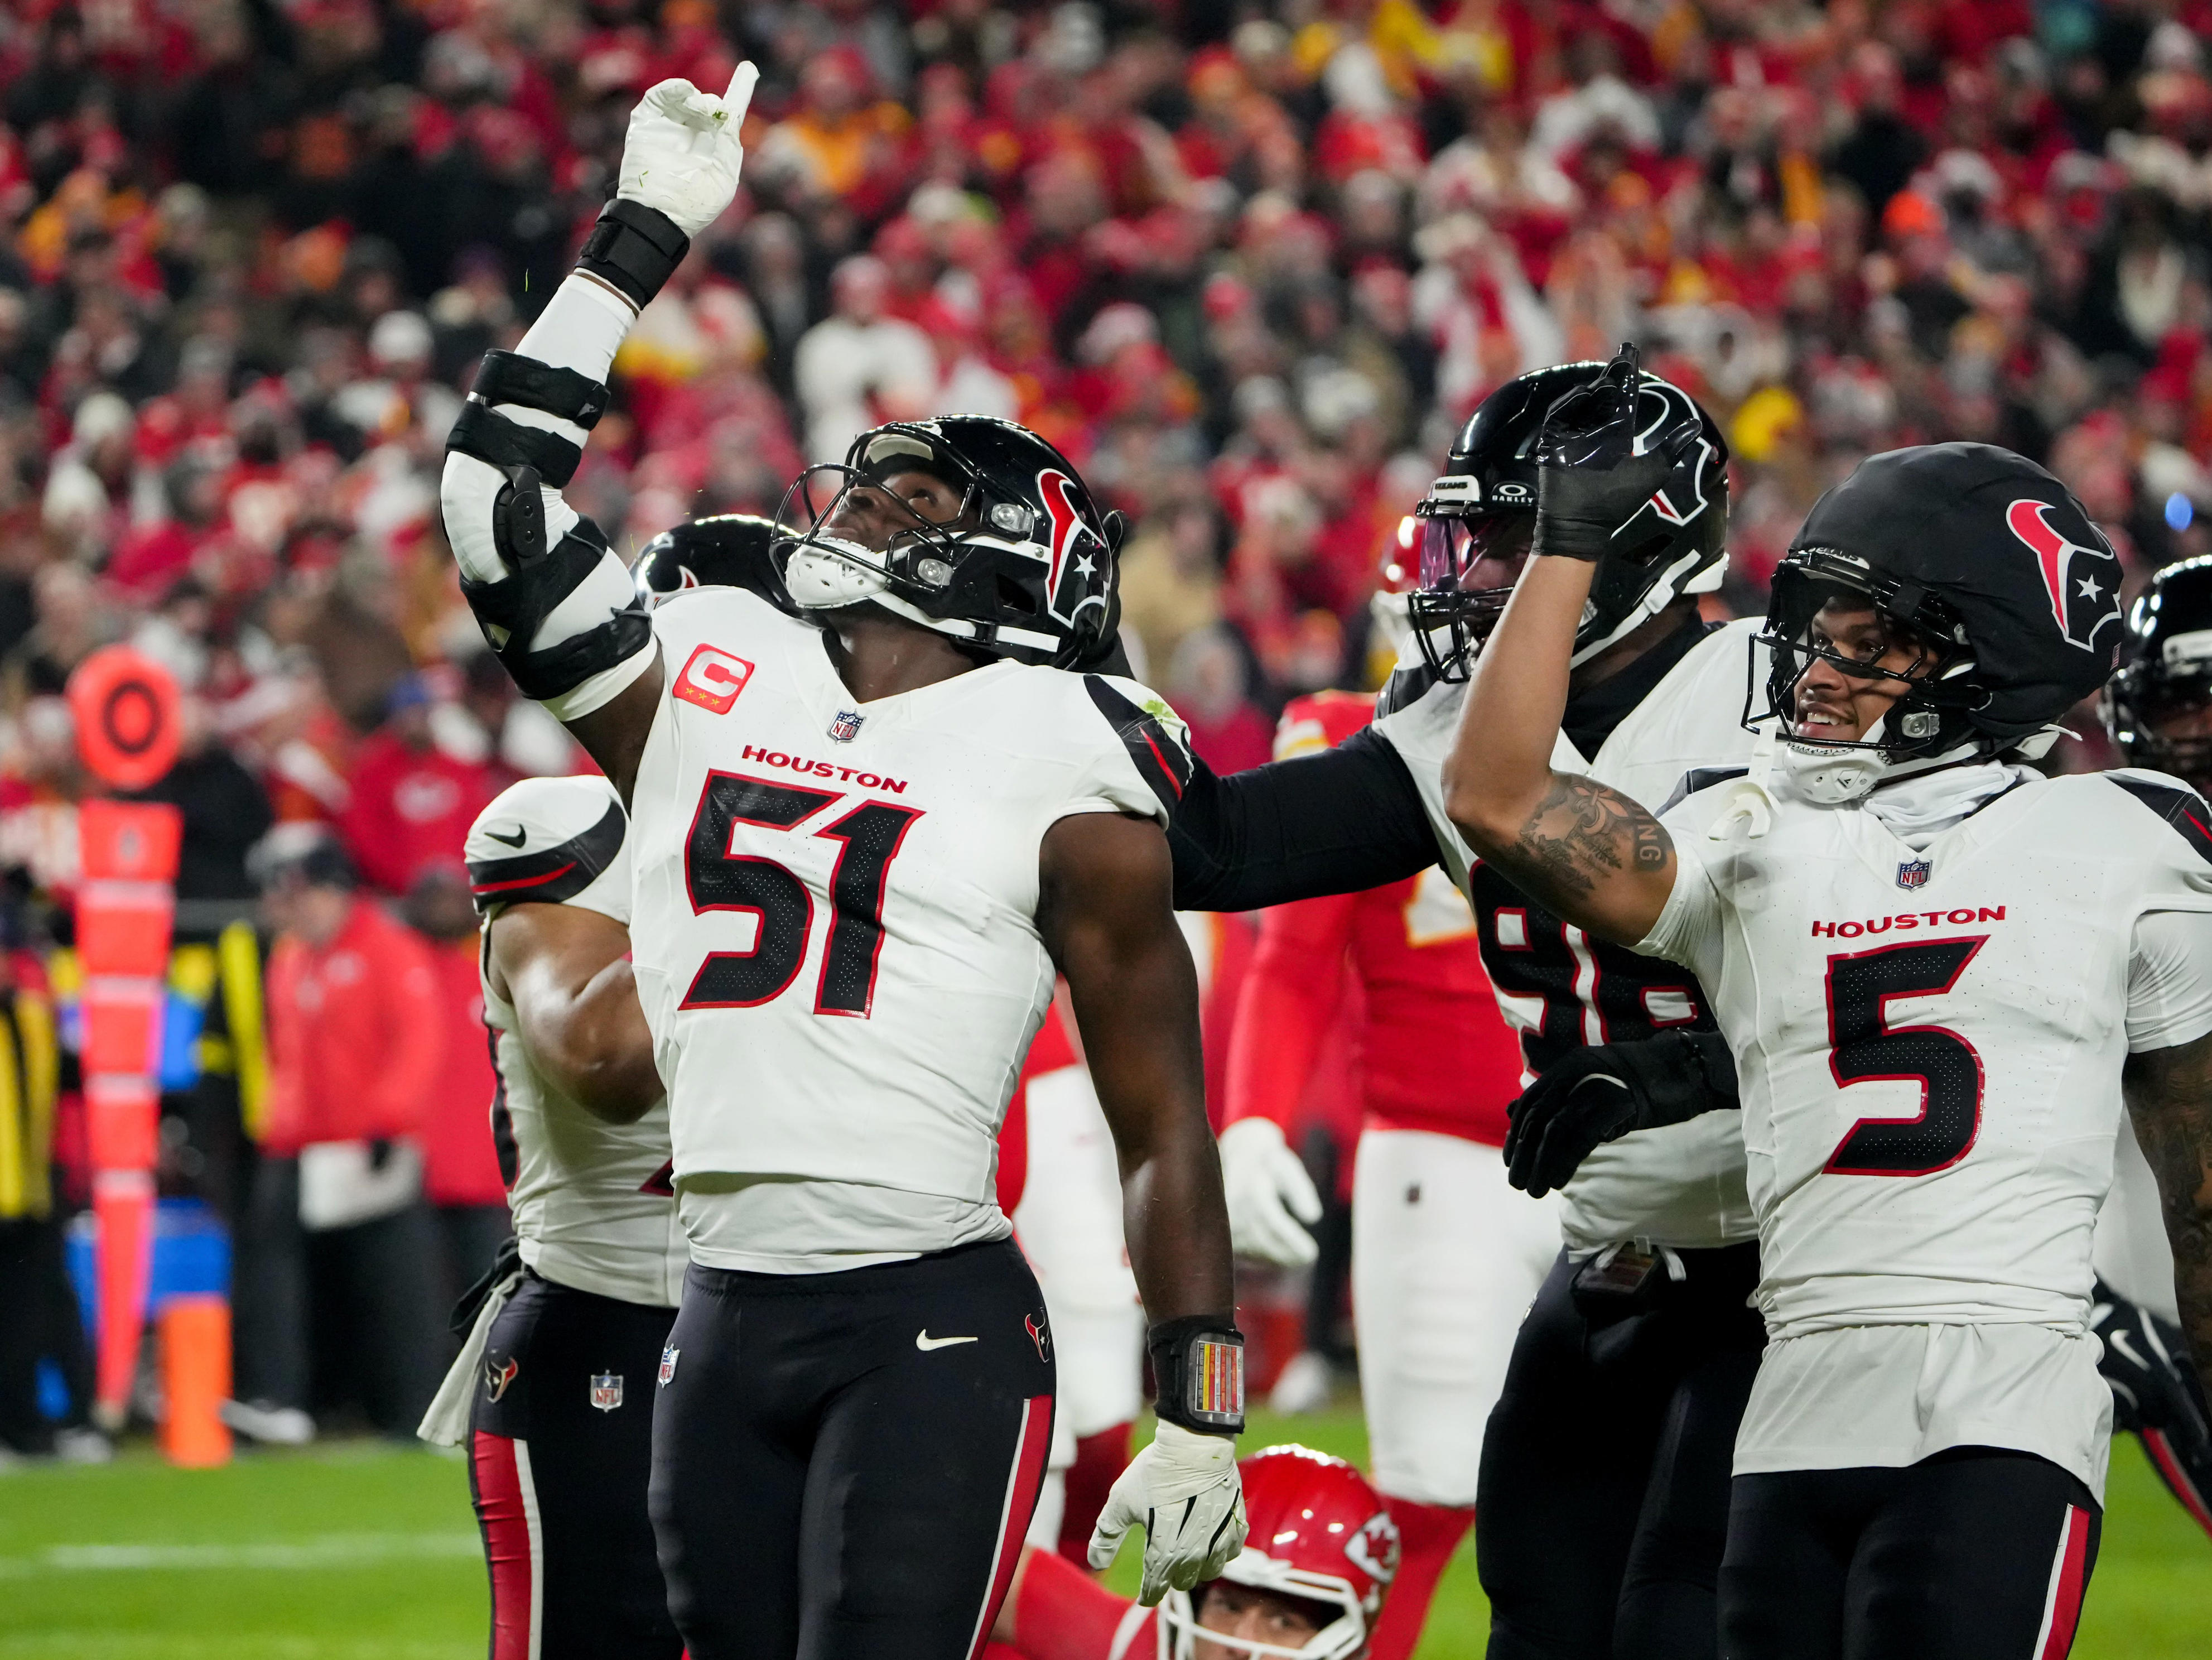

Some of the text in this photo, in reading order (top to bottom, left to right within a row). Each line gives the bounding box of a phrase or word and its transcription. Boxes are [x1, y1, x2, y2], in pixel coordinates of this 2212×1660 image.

[1492, 494, 1534, 503] OAKLEY
[687, 650, 746, 697] C
[832, 722, 854, 738] NFL
[741, 745, 908, 793] HOUSTON
[1901, 872, 1925, 884] NFL
[677, 768, 927, 1019] 51
[1811, 905, 2006, 938] HOUSTON
[1821, 934, 1991, 1177] 5
[661, 1364, 672, 1379] NFL
[596, 1389, 616, 1403] NFL
